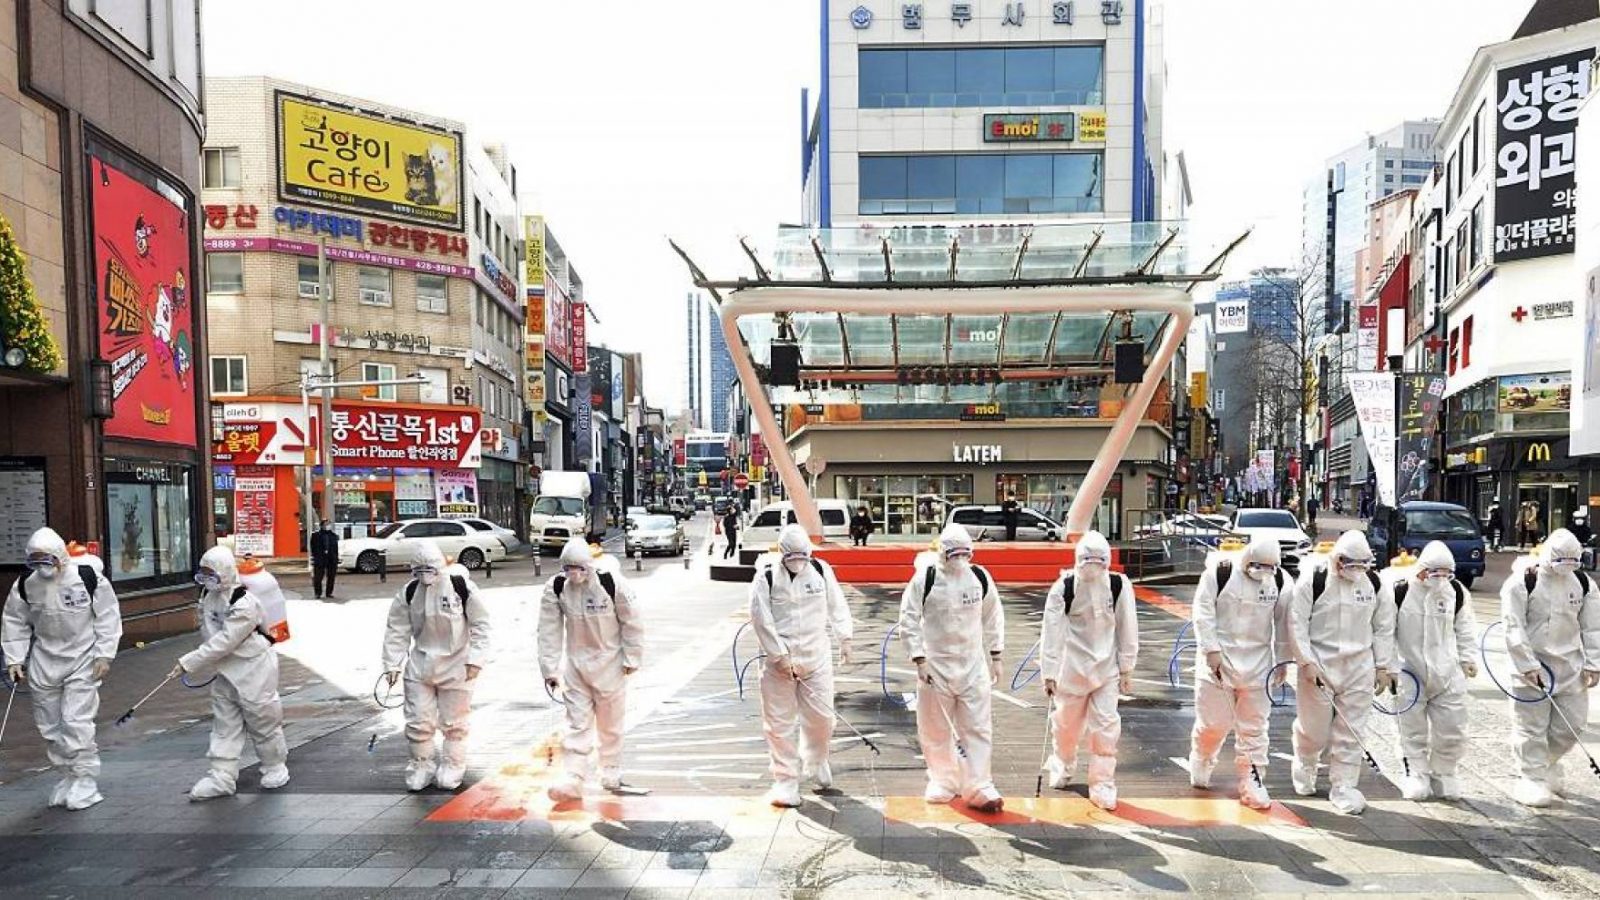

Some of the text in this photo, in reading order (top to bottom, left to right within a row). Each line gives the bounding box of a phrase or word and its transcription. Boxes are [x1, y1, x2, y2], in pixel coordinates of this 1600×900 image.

[1497, 59, 1591, 131] 성형
[299, 128, 390, 168] 고양이
[306, 159, 390, 194] Cafe
[1219, 306, 1246, 317] YBM
[331, 444, 367, 458] Smart
[369, 445, 406, 459] Phone
[953, 445, 1002, 463] LATEM
[136, 466, 171, 481] CHANEL
